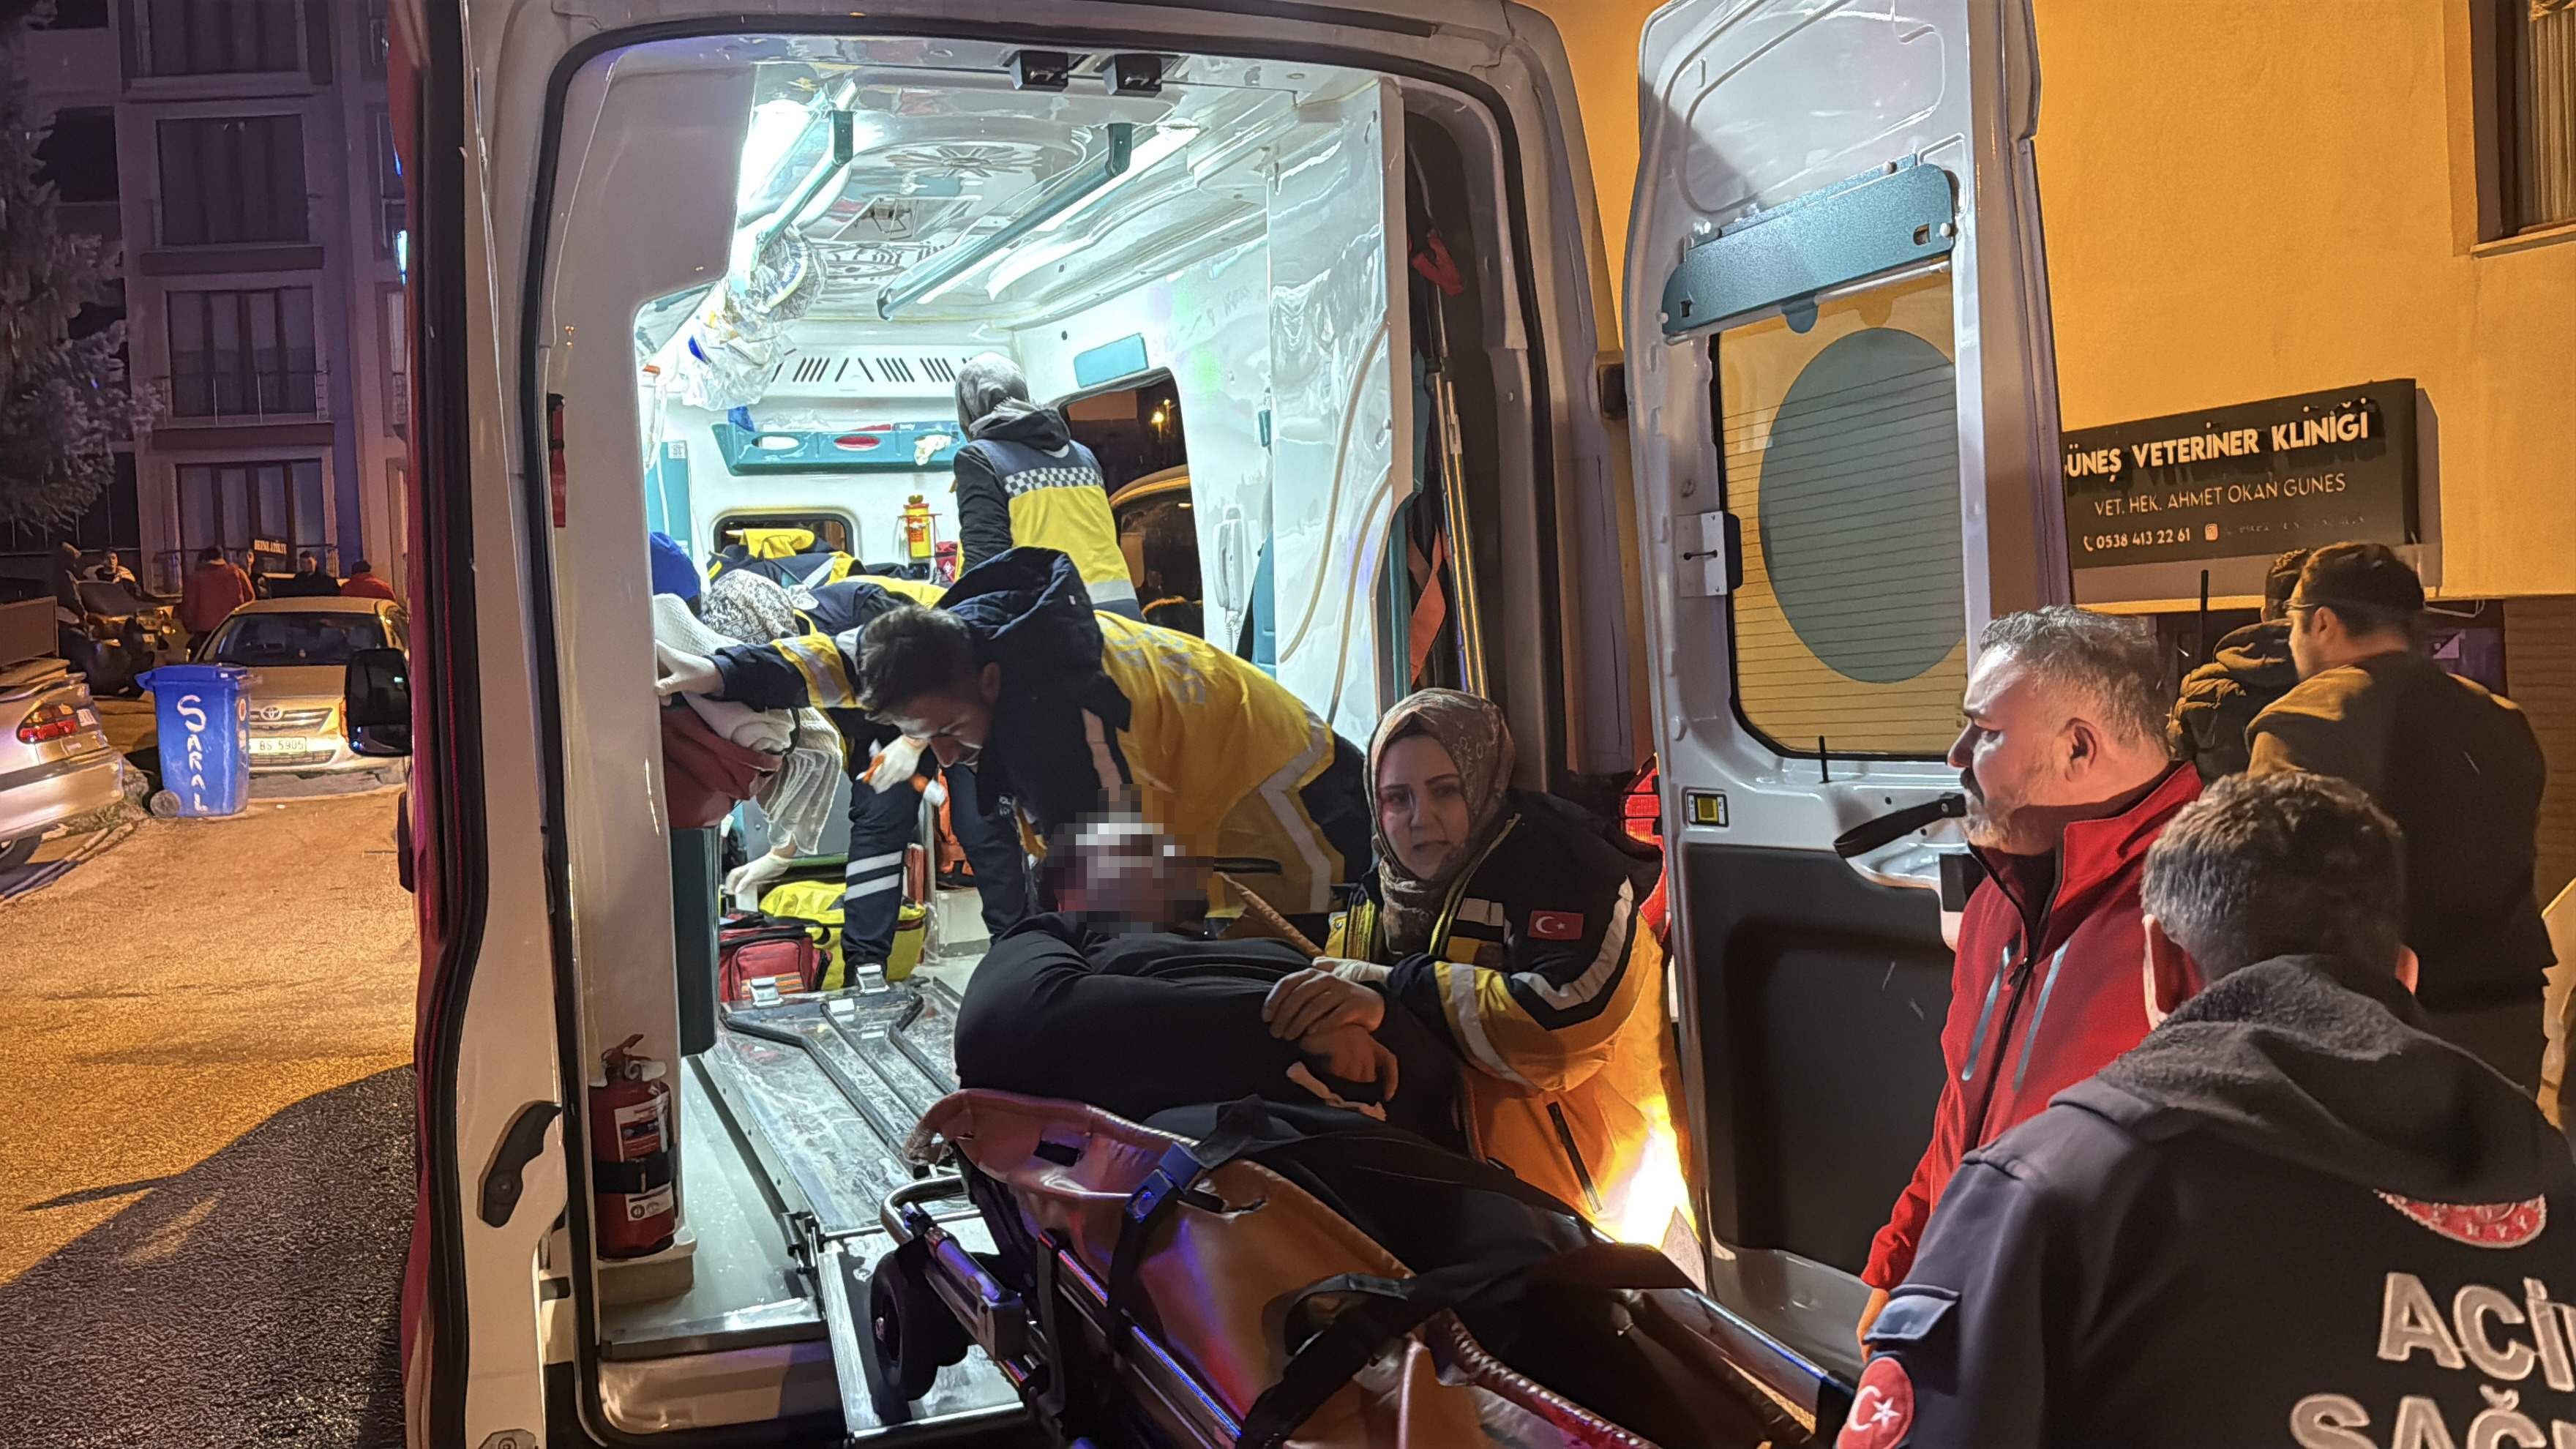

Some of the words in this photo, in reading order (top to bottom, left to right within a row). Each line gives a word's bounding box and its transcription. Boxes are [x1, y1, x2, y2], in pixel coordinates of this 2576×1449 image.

[2064, 443, 2122, 483] ÜNEŞ
[2131, 421, 2261, 469] VETERİNER
[2271, 397, 2369, 452] KLİNİĞİ
[2094, 498, 2125, 516] VET.
[2129, 494, 2163, 514] HEK.
[2168, 486, 2223, 509] AHMET
[2228, 481, 2278, 503] OKAN
[2096, 533, 2129, 550] 0538
[2132, 531, 2153, 546] 413
[2156, 528, 2174, 544] 22
[2177, 527, 2191, 543] 61
[278, 739, 304, 751] 5905
[2377, 1271, 2576, 1391] ACİ
[2289, 1385, 2576, 1449] SAĞ
